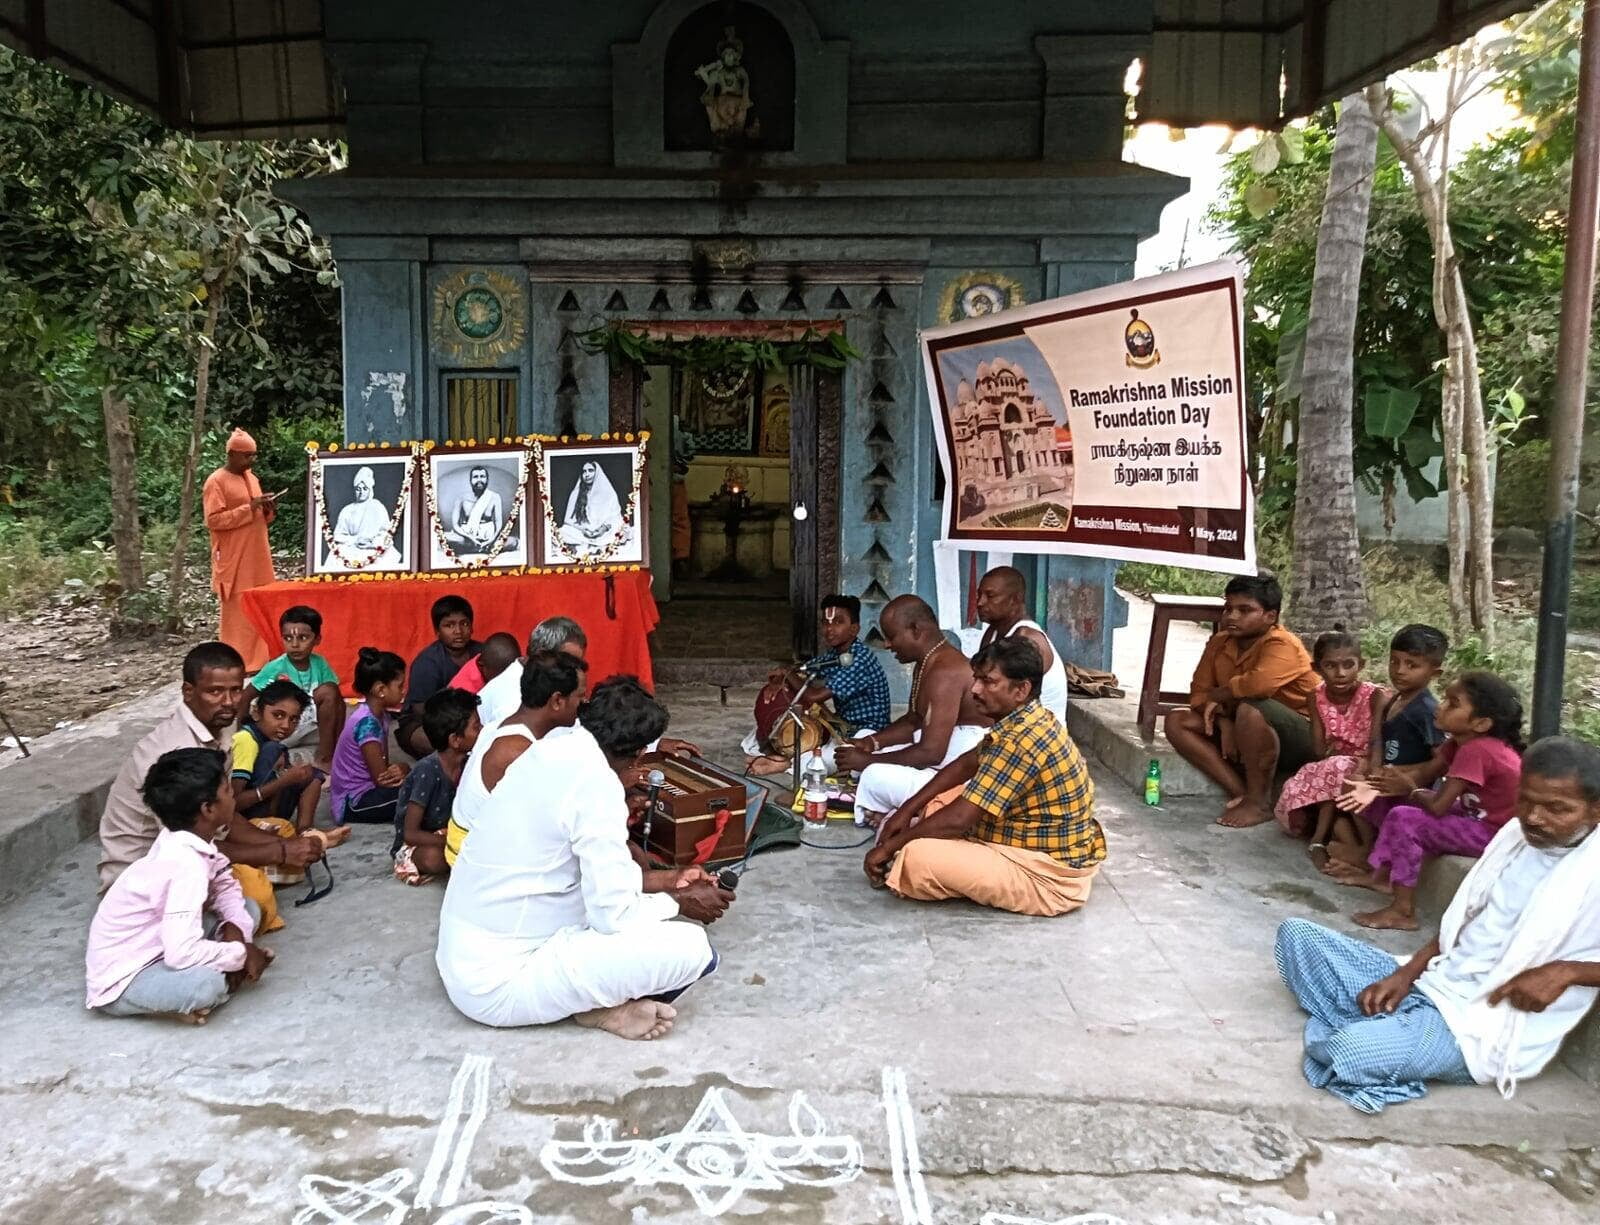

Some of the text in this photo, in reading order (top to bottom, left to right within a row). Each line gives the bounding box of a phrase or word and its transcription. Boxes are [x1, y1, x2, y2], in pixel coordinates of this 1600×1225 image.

[1069, 374, 1233, 407] Ramakrishna Mission
[1093, 403, 1211, 429] Foundation Day
[1090, 434, 1222, 461] ராமகிருஷ்ண இயக்க
[1114, 461, 1199, 487] நிறுவன நாள்
[1073, 516, 1114, 529] Ramakrishna
[1114, 518, 1142, 534] Mission,
[1189, 526, 1238, 542] 1 May, 2024
